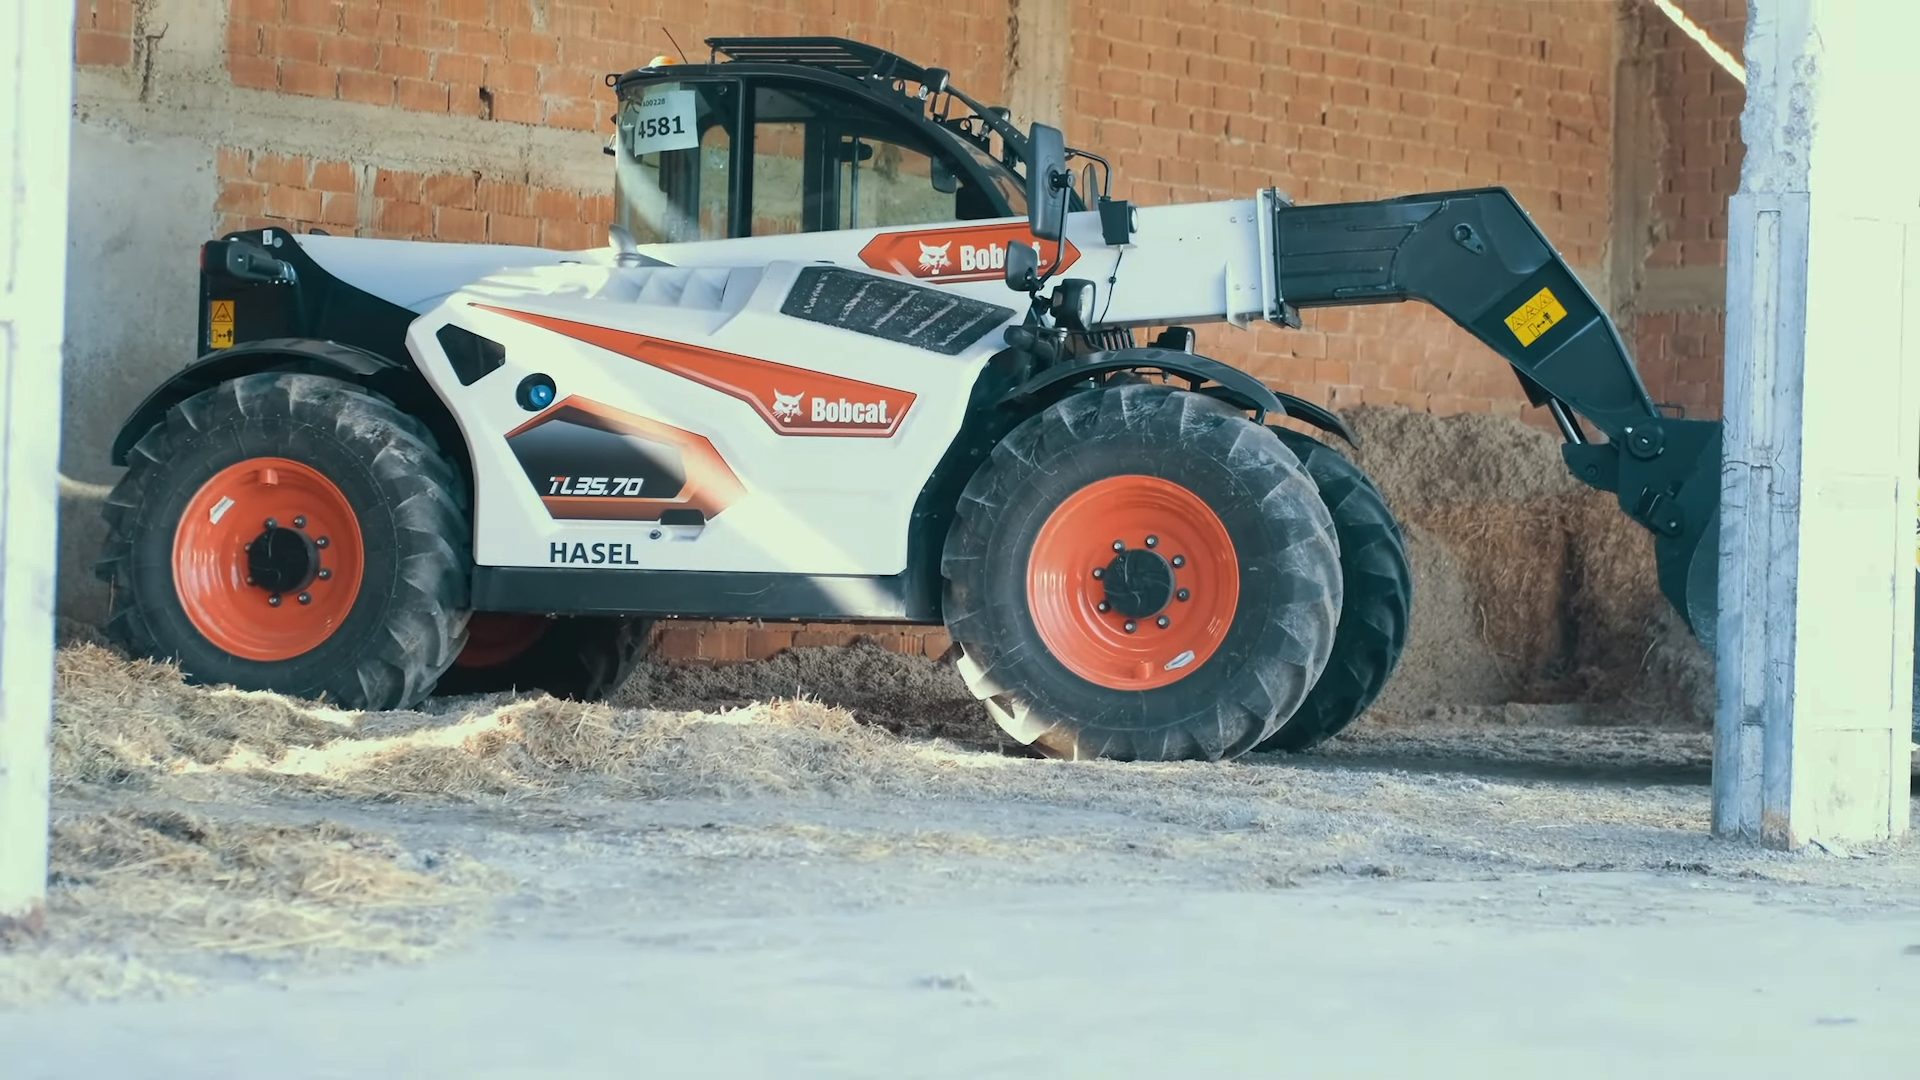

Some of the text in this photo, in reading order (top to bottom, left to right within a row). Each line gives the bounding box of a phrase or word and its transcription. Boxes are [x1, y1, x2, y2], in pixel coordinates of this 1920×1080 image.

[638, 115, 685, 139] 4581
[960, 241, 1042, 271] Bobt
[811, 397, 888, 424] Bobcat
[549, 476, 644, 496] TL35.70
[550, 542, 639, 565] HASEL
